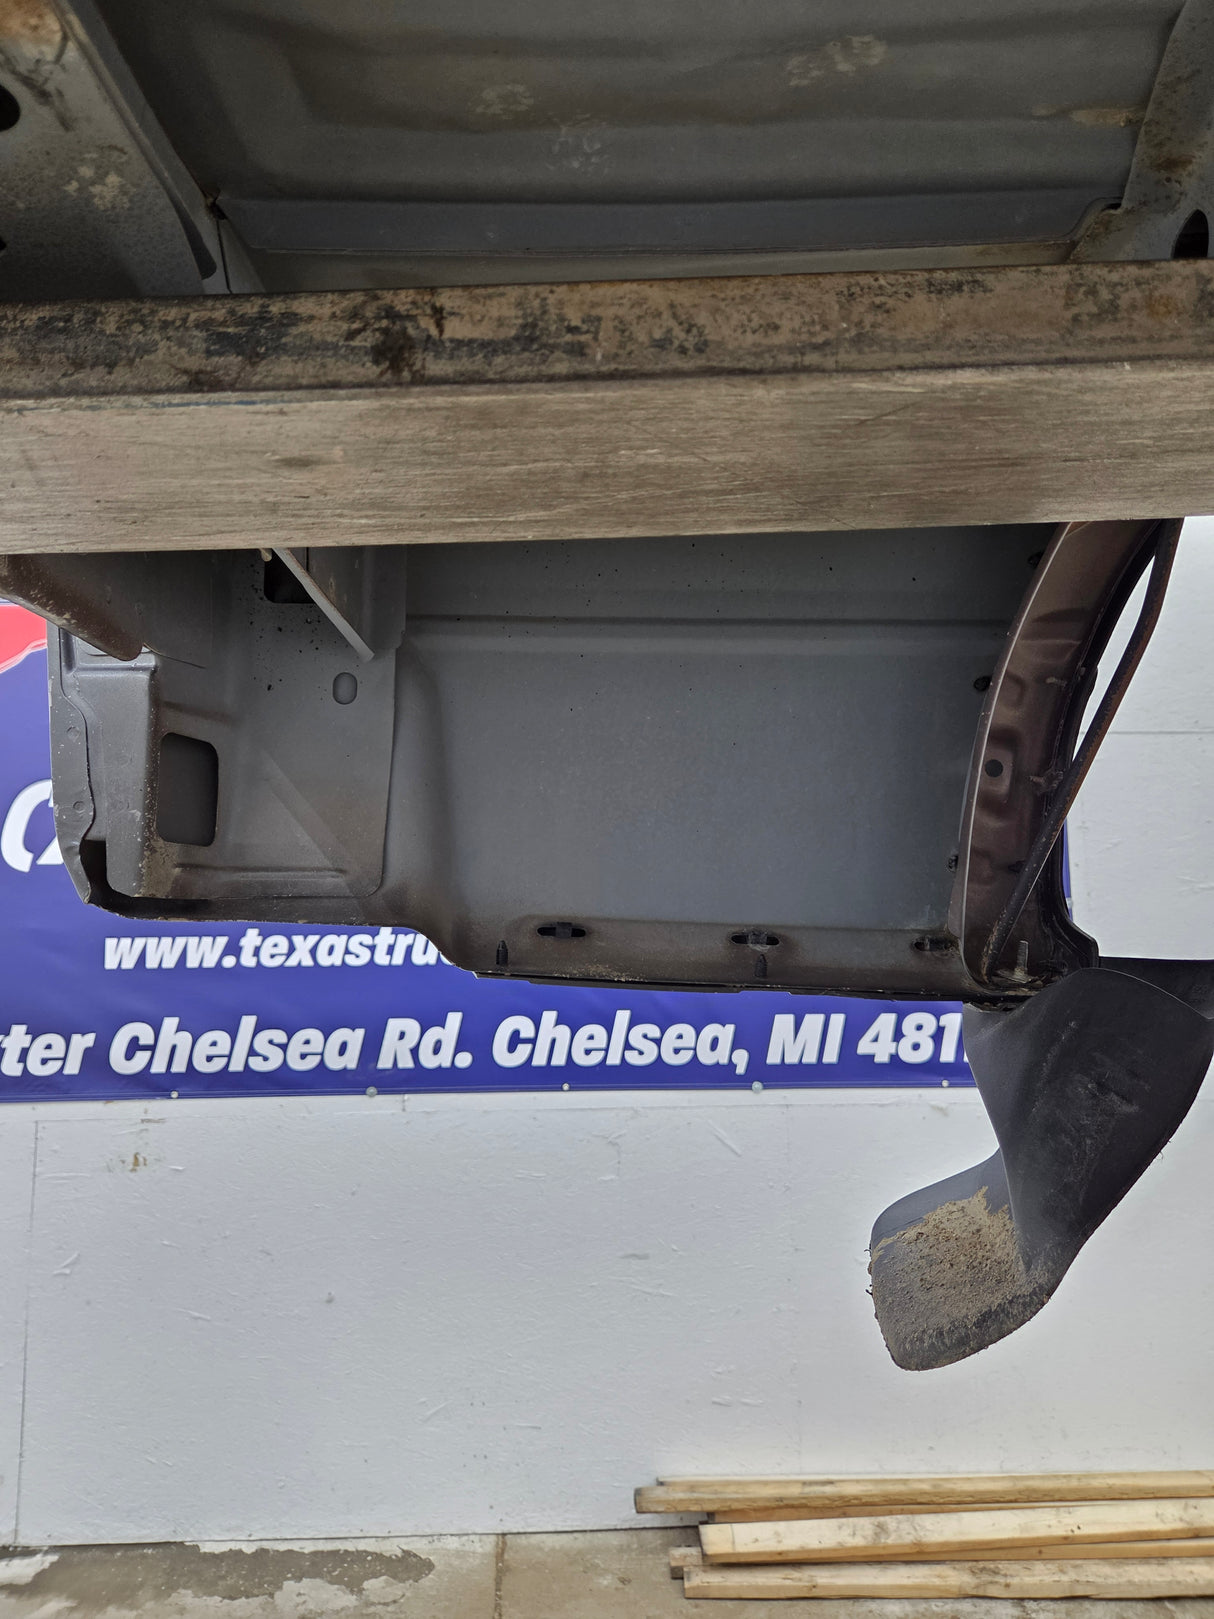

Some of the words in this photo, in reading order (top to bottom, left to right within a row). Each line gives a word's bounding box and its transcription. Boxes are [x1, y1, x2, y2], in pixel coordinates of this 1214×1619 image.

[104, 927, 456, 969] www.texastru
[0, 1025, 96, 1077] ter
[109, 1015, 365, 1075] Chelsea
[376, 1012, 473, 1069] Rd.
[492, 1010, 748, 1075] Chelsea,
[766, 1014, 846, 1064] MI
[857, 1012, 969, 1064] 481
